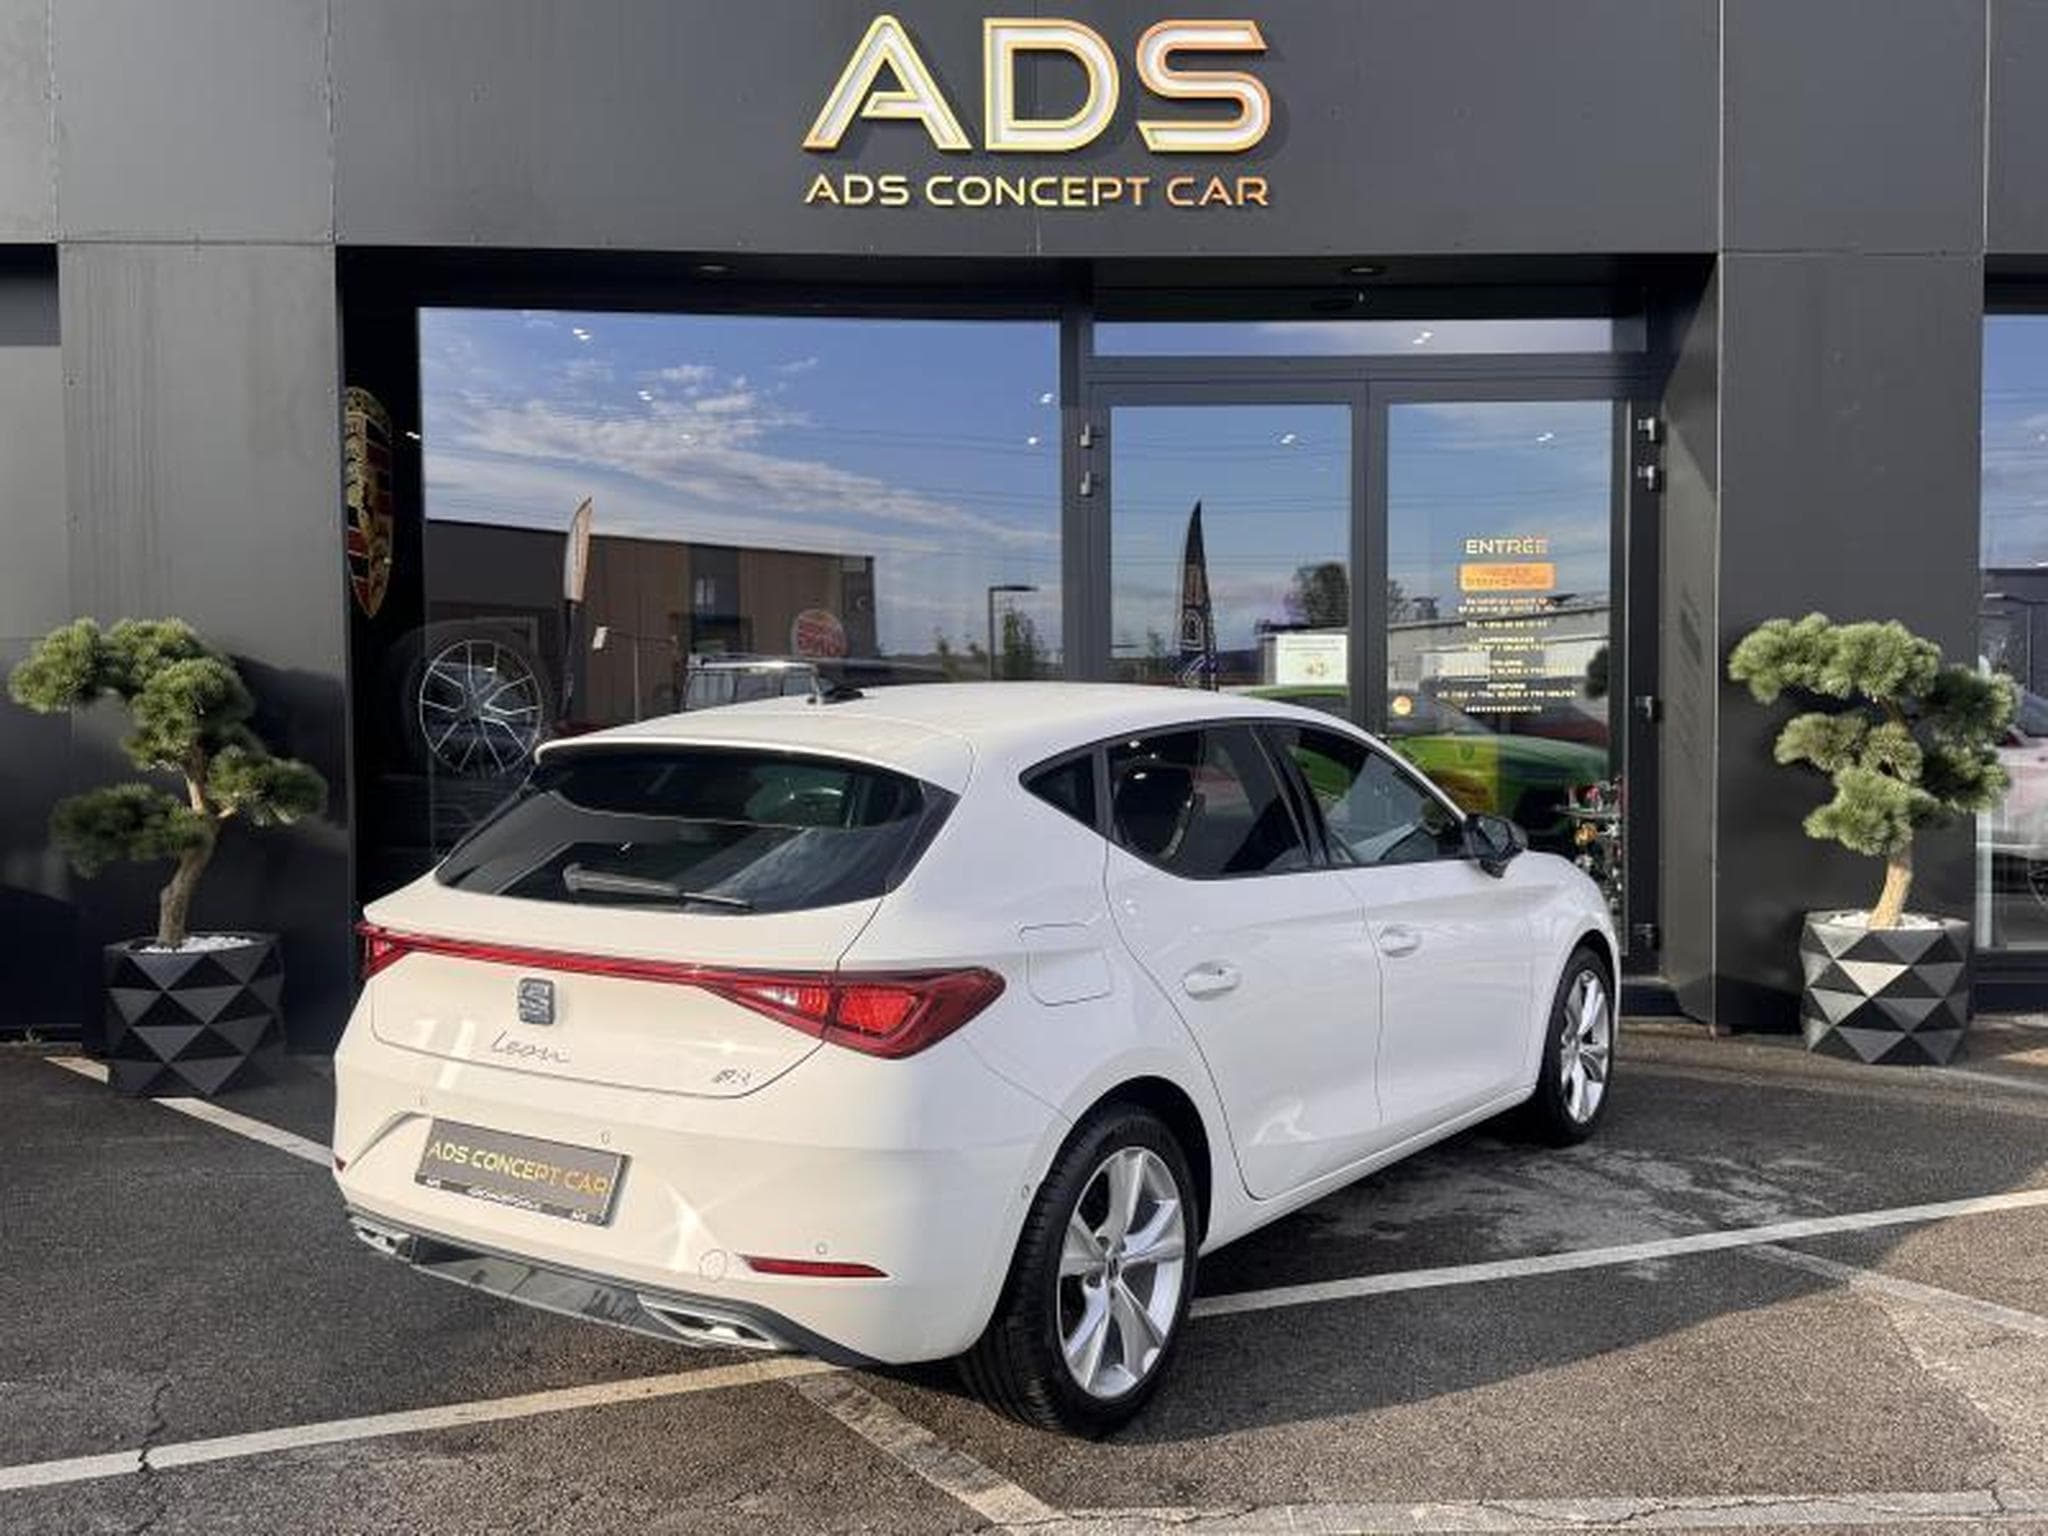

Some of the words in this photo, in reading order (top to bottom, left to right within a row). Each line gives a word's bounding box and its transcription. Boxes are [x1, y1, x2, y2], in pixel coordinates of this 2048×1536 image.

[802, 14, 1271, 152] ADS
[805, 174, 908, 206] ADS
[925, 176, 1150, 207] CONCEPT
[1166, 176, 1269, 207] CAR
[1465, 536, 1548, 554] ENTRÉE
[427, 1141, 470, 1164] ADS
[470, 1150, 562, 1186] CONCEPT
[563, 1171, 609, 1198] CAR
